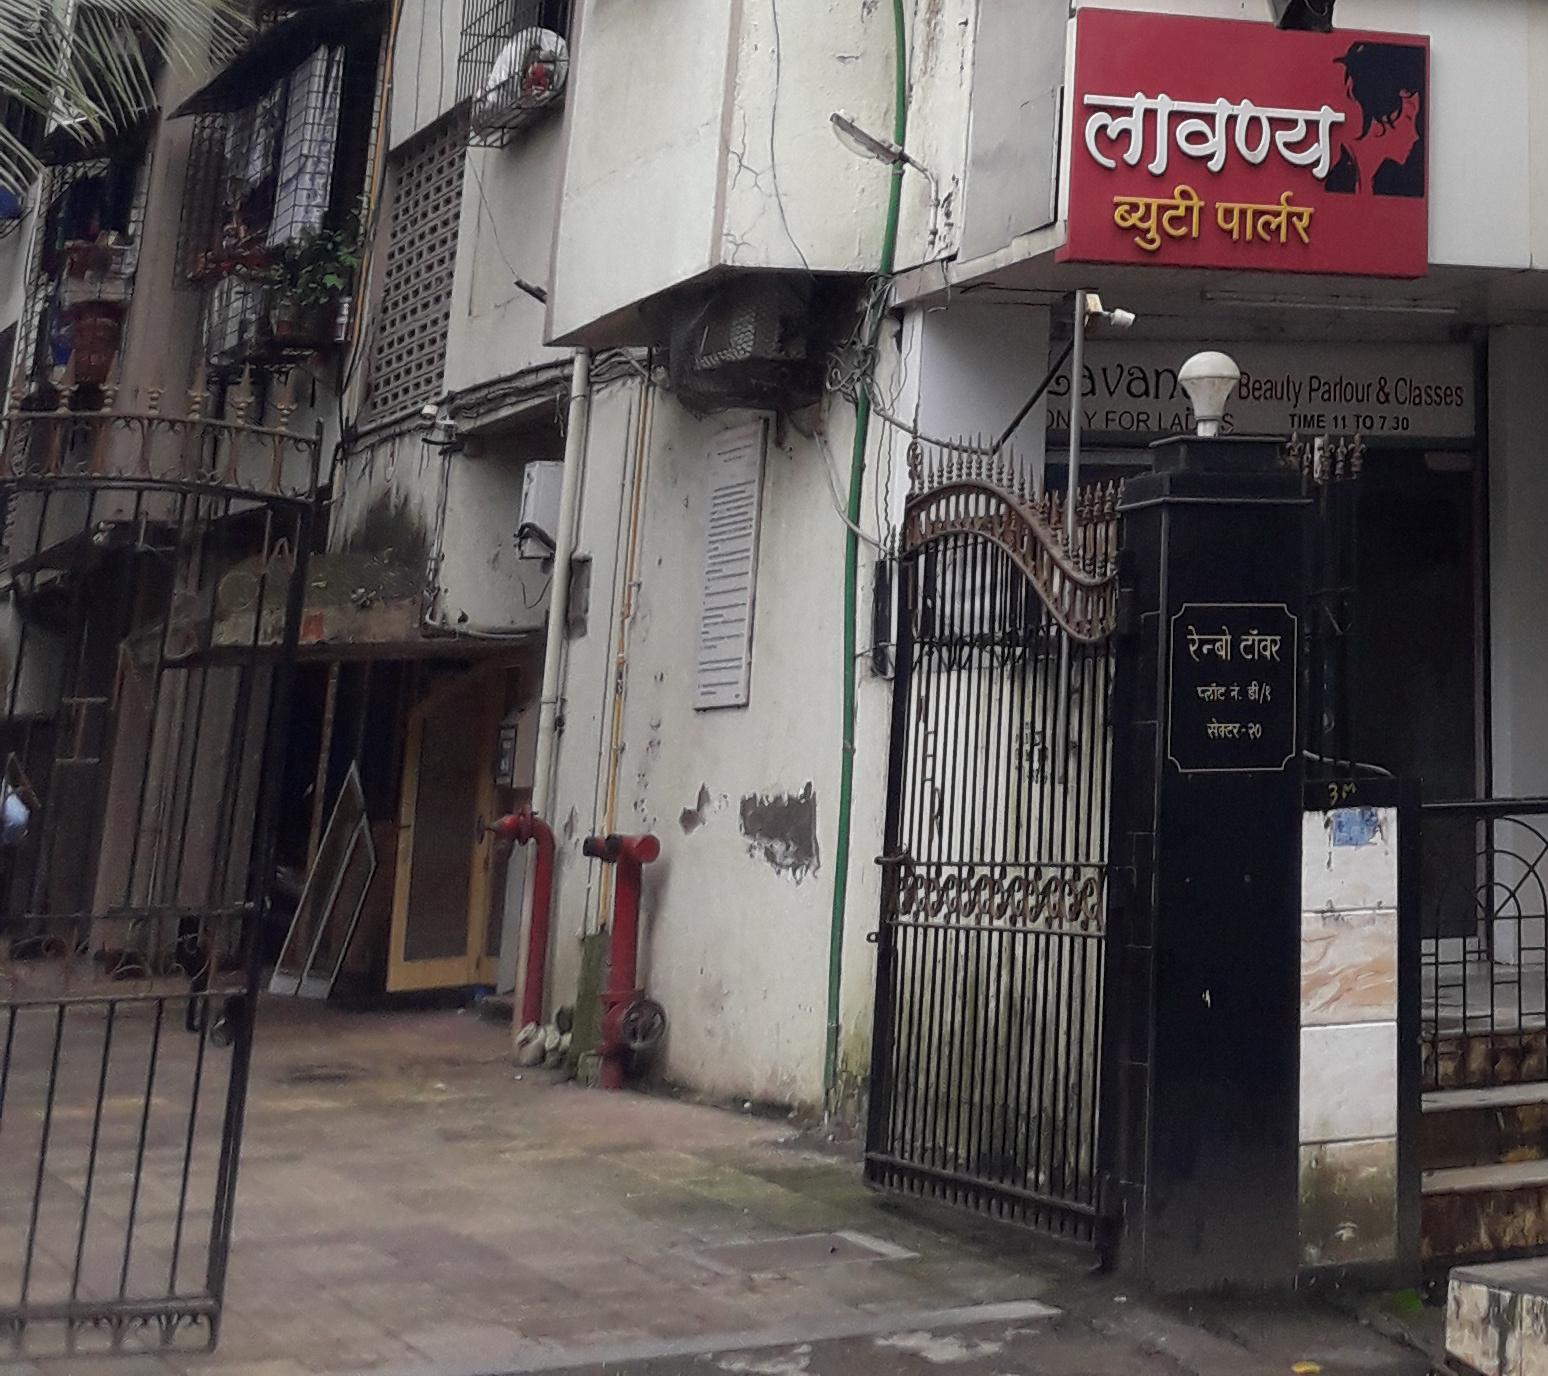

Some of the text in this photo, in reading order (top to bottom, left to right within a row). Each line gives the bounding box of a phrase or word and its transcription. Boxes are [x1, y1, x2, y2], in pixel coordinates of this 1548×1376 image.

[1084, 92, 1345, 178] लावण्य
[1114, 185, 1314, 251] ब्युटी पार्लर
[1239, 372, 1301, 408] Beauty
[1309, 376, 1372, 404] Parlour
[1376, 376, 1390, 404] &
[1395, 377, 1464, 406] Classes
[1047, 409, 1096, 429] ONY
[1105, 410, 1150, 430] FOR
[1289, 413, 1326, 429] TIME
[1332, 414, 1346, 430] 11
[1354, 414, 1374, 430] TO
[1240, 628, 1281, 662] टॉवर
